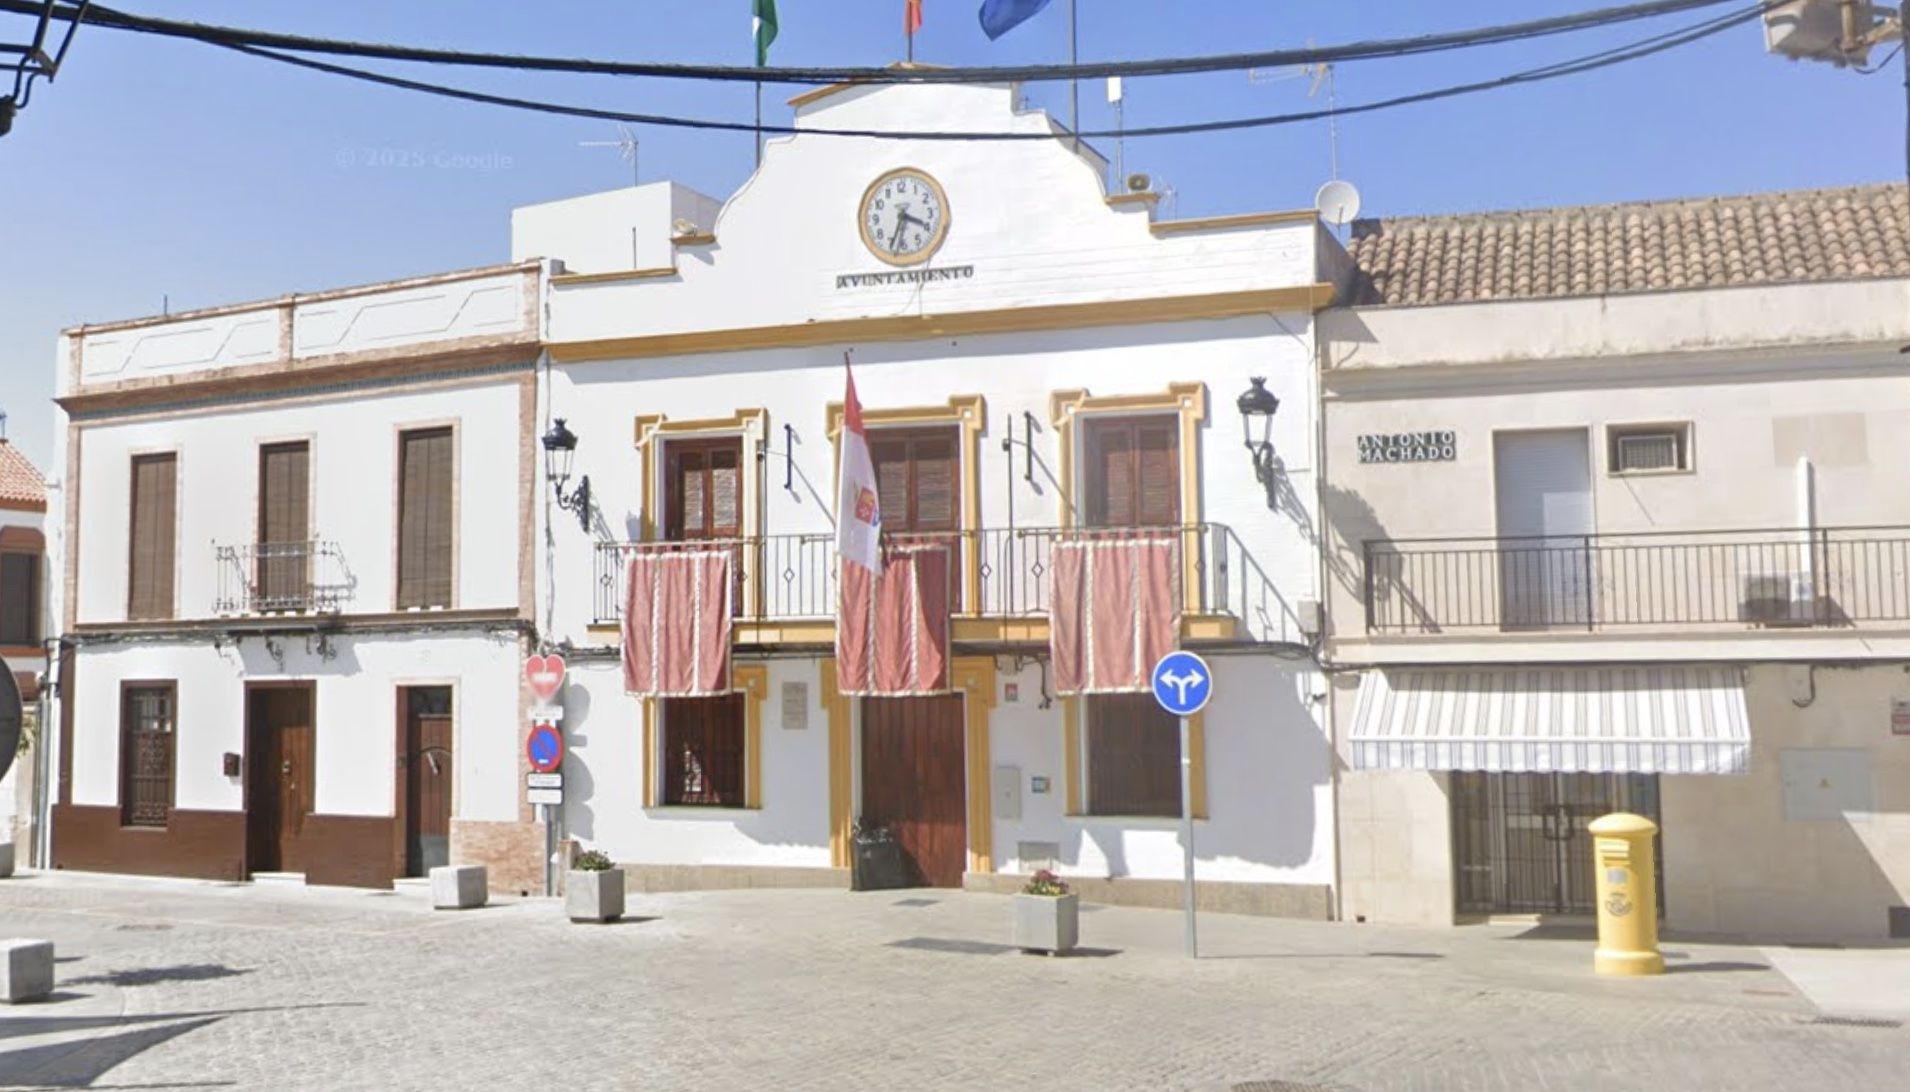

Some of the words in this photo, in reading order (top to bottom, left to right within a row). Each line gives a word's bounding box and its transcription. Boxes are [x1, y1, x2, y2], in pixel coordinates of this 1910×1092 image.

[897, 182, 906, 193] 12
[922, 193, 929, 204] 2
[875, 199, 884, 211] 10
[927, 207, 933, 219] 3
[872, 214, 880, 226] 9
[877, 228, 884, 240] 8
[914, 233, 921, 246] 5
[1359, 432, 1454, 448] ANTONIO
[1359, 446, 1454, 461] MACHADO
